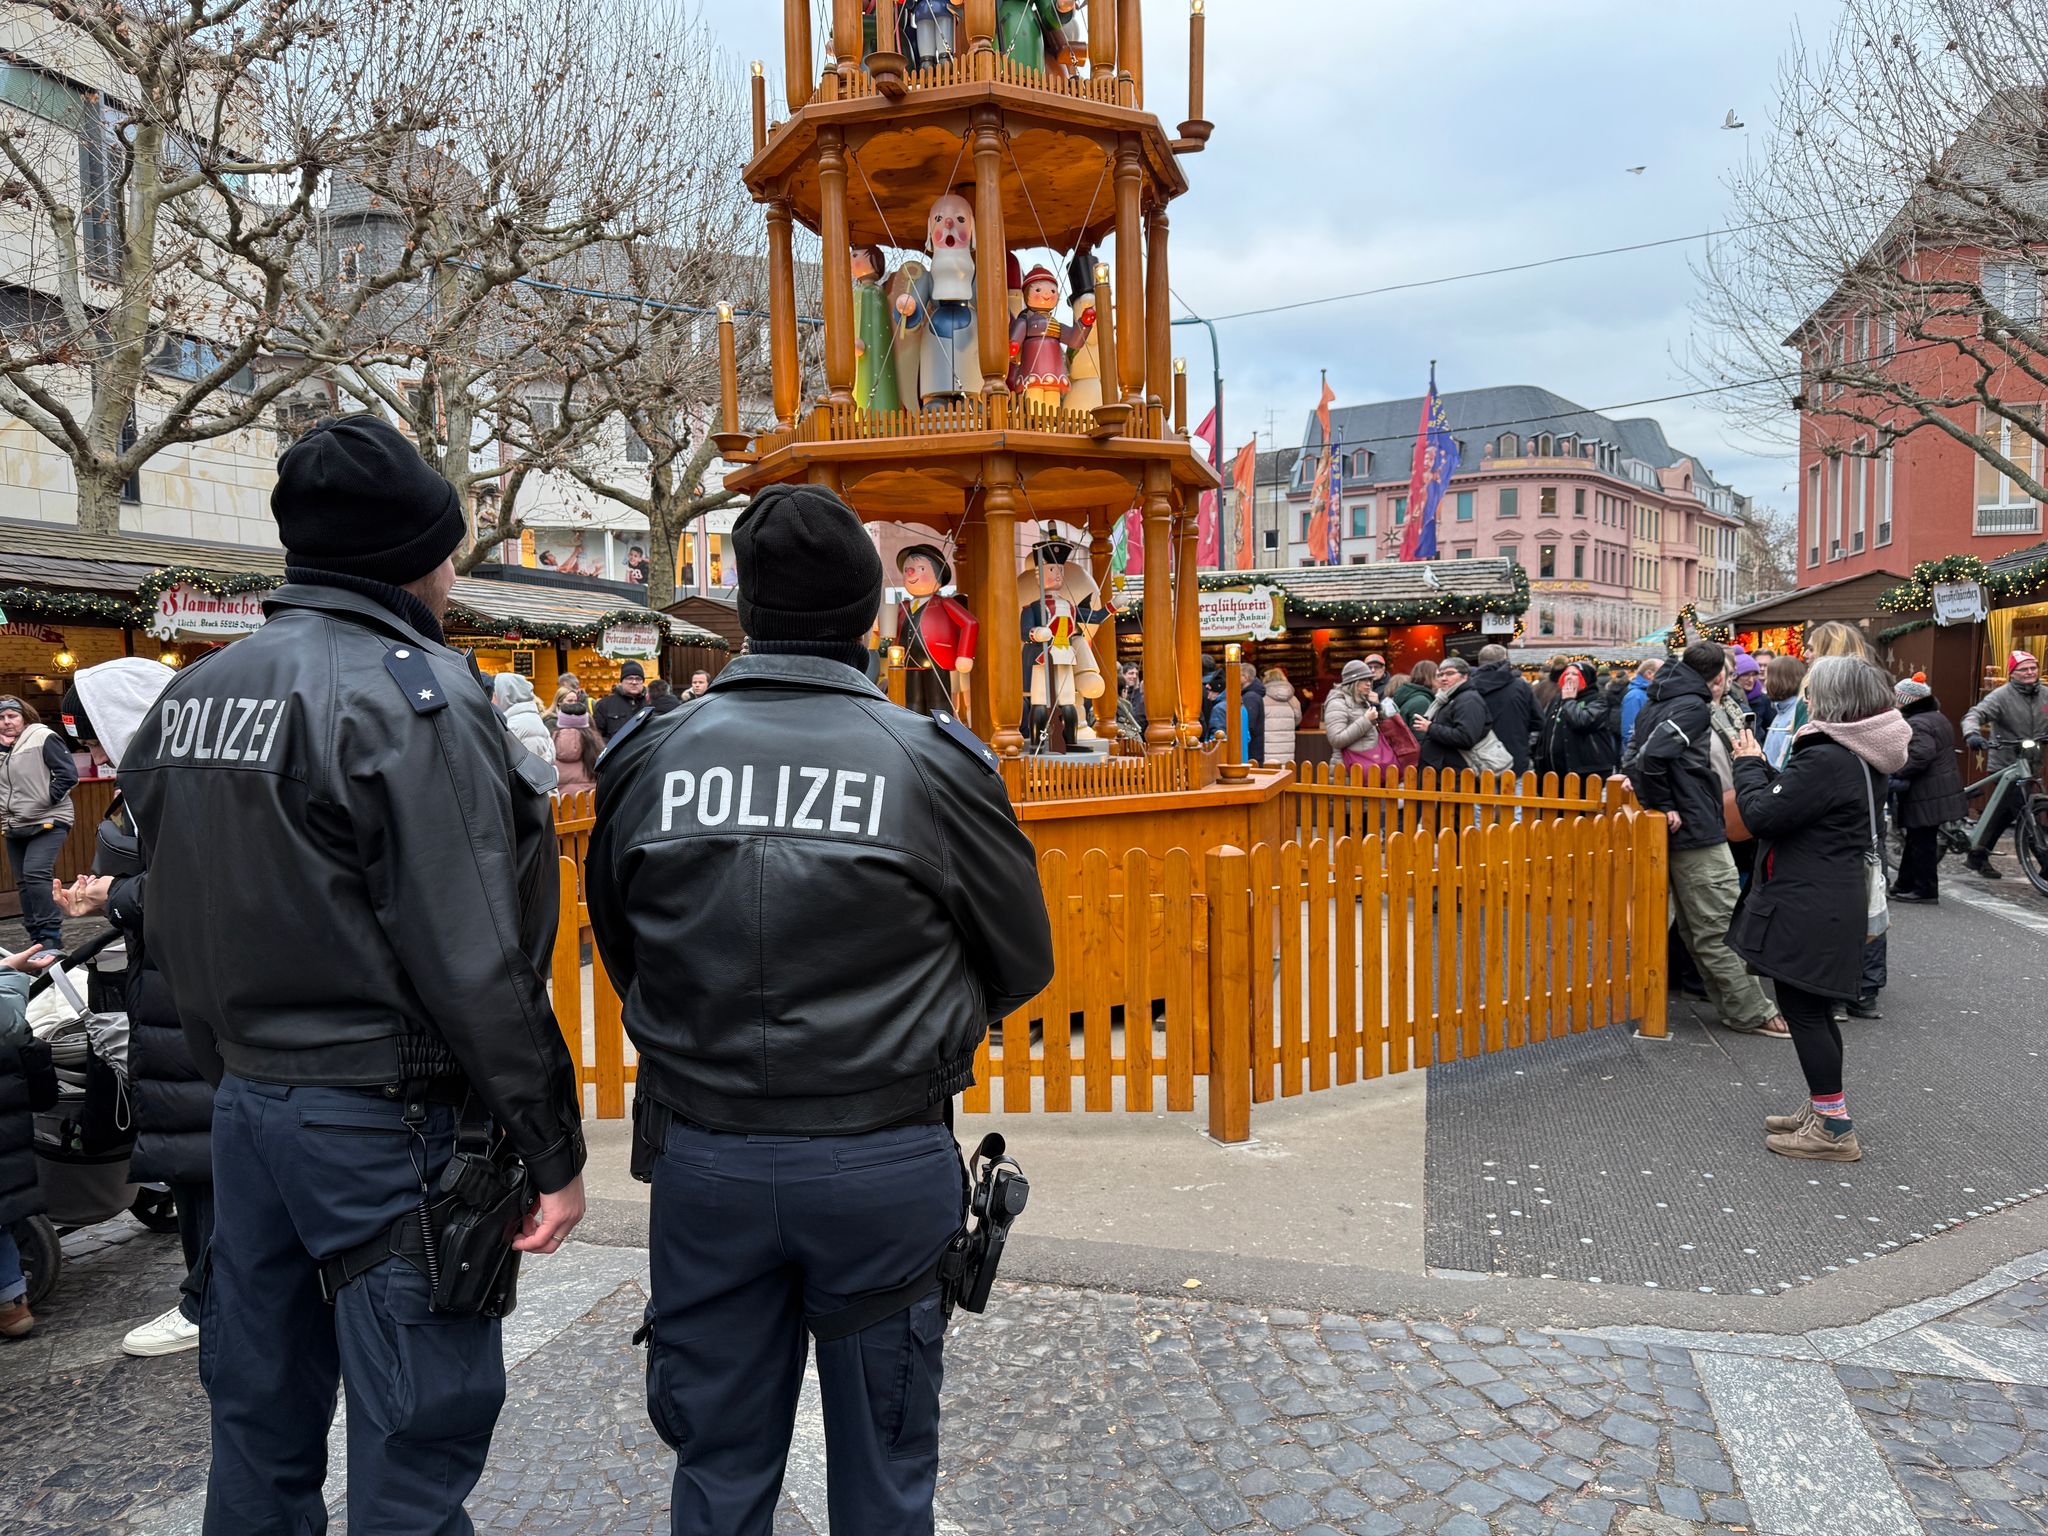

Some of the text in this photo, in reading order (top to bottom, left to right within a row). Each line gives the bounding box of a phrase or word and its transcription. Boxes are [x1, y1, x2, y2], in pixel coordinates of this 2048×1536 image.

[1199, 597, 1267, 616] erglühwein
[1199, 614, 1236, 625] gischem
[156, 697, 286, 762] POLIZEI
[661, 765, 886, 836] POLIZEI
